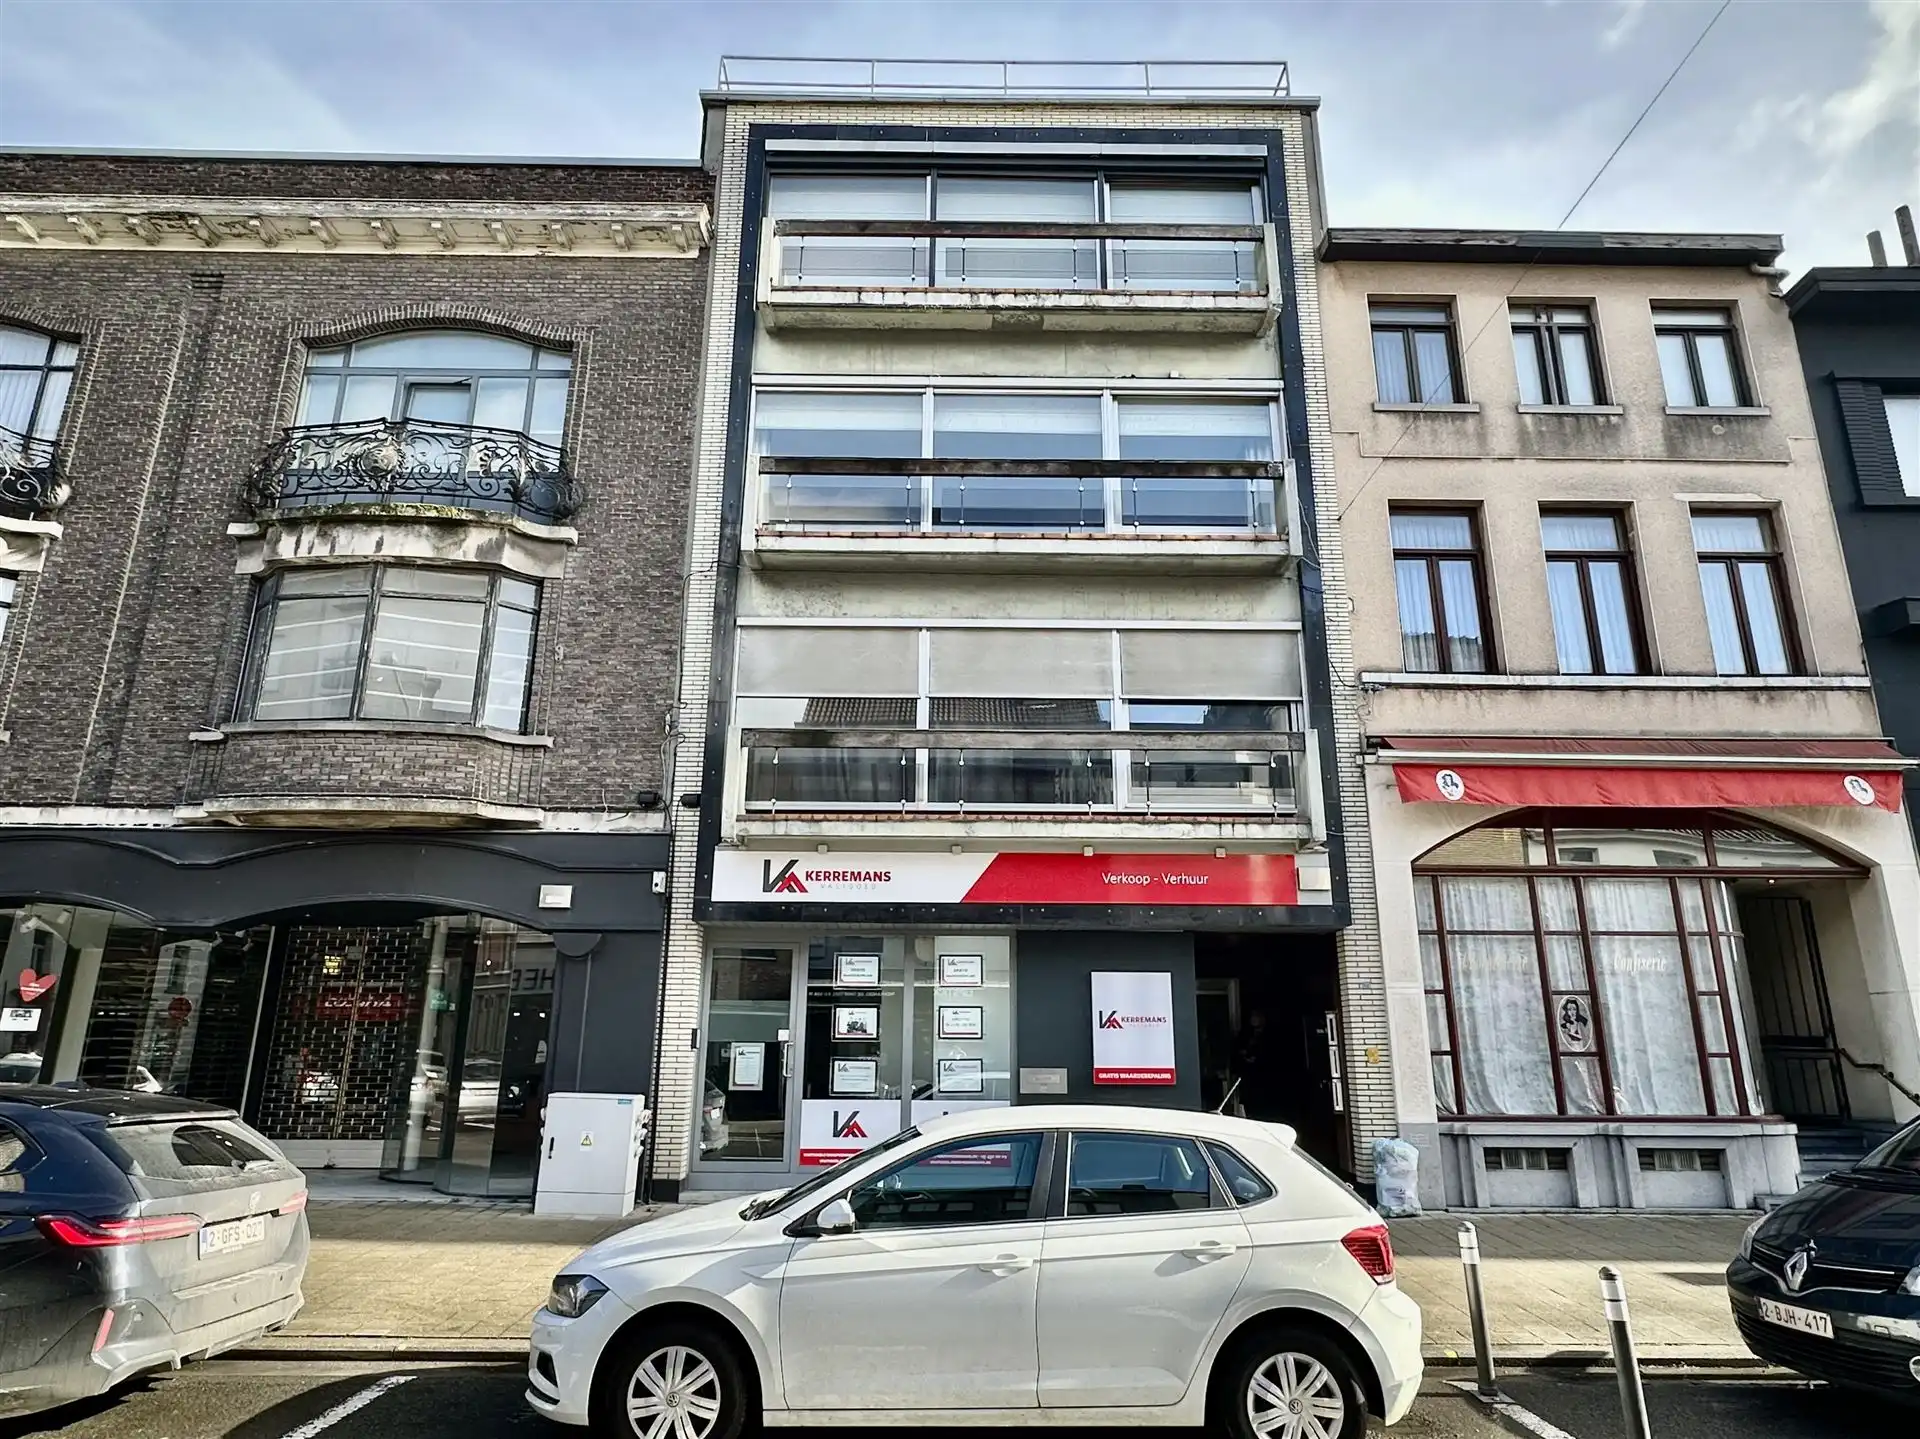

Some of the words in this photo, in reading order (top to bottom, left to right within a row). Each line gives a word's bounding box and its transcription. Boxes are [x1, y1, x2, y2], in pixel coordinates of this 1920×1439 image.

[805, 870, 892, 882] KERREMANS
[1101, 872, 1151, 886] Verkoop
[1160, 872, 1209, 885] Verhuur
[1762, 1301, 1827, 1334] 2-BJH-417
